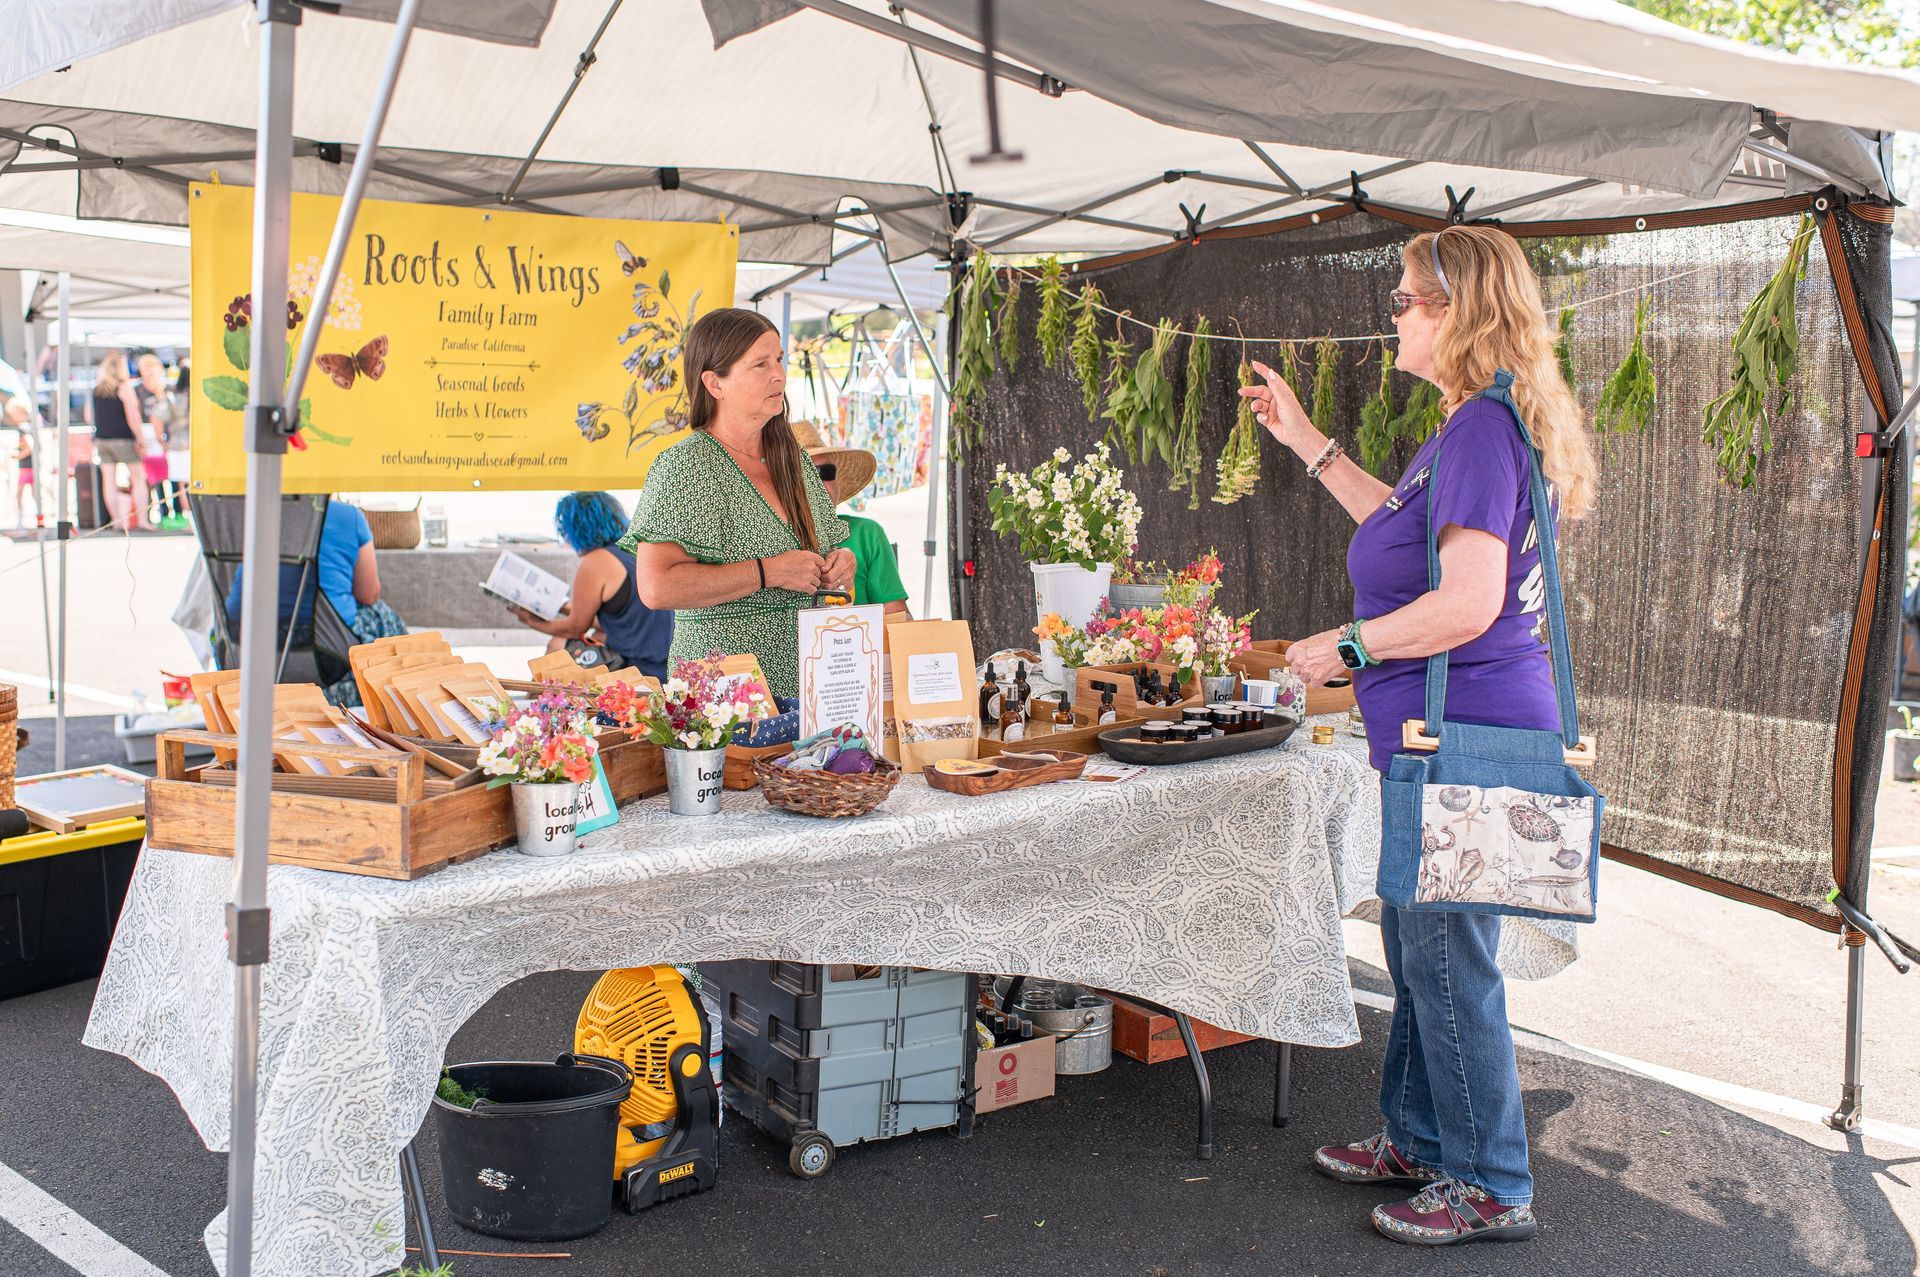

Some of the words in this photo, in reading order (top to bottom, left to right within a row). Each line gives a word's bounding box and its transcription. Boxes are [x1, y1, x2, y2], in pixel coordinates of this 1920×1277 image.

[363, 233, 460, 287] Roots
[474, 244, 496, 289] &
[507, 245, 600, 308] Wings
[438, 300, 494, 331] Family
[499, 303, 538, 326] Farm
[441, 336, 479, 351] Paradise
[483, 337, 526, 353] California
[436, 373, 488, 393] Seasonal
[492, 374, 525, 392] Goods
[435, 401, 468, 418] Herbs
[473, 402, 481, 418] &
[485, 401, 528, 418] Flowers
[381, 450, 568, 470] rootsandwingsparadiseca@gmail.com
